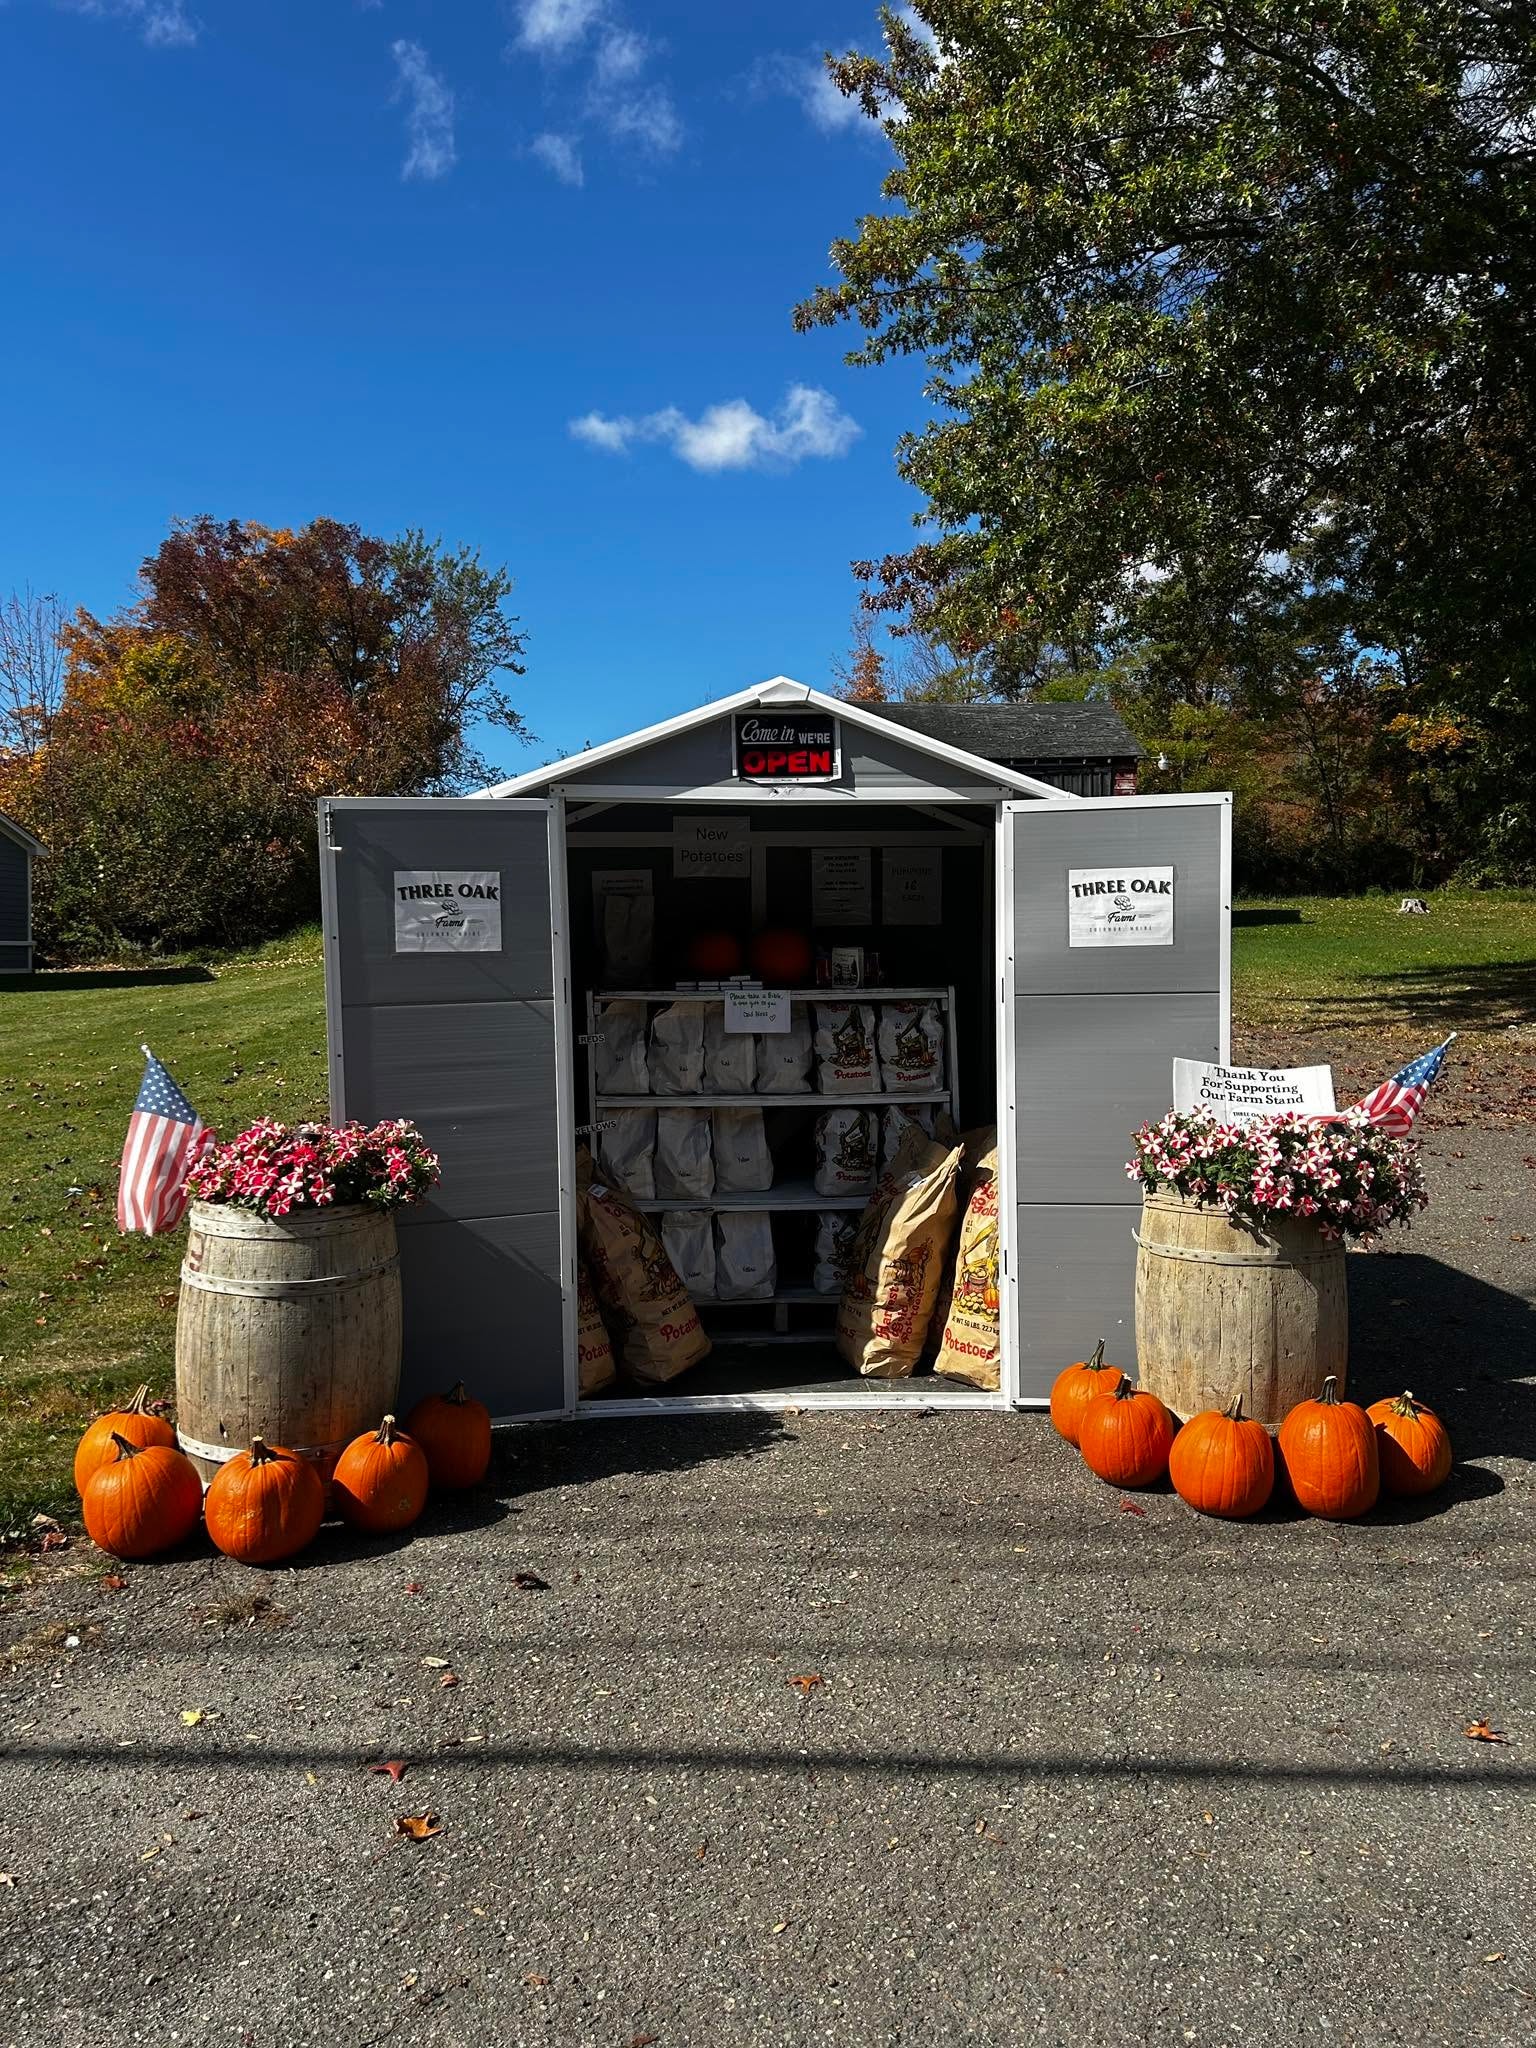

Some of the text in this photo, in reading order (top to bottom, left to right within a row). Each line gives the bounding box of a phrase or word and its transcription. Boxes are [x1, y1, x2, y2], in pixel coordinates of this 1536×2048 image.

[741, 720, 831, 744] Come in WE'RE
[743, 750, 831, 774] OPEN
[696, 828, 728, 841] New
[681, 849, 744, 863] Potatoes
[397, 884, 499, 901] THREE OAK
[1072, 879, 1172, 898] THREE OAK
[434, 915, 466, 928] Farms
[1107, 911, 1137, 923] Farms
[580, 1034, 605, 1043] REDS
[1214, 1067, 1285, 1082] Thank You
[1202, 1076, 1298, 1094] For Supporting
[1200, 1088, 1304, 1105] Our Farm Stand
[945, 1327, 995, 1361] Potatoes
